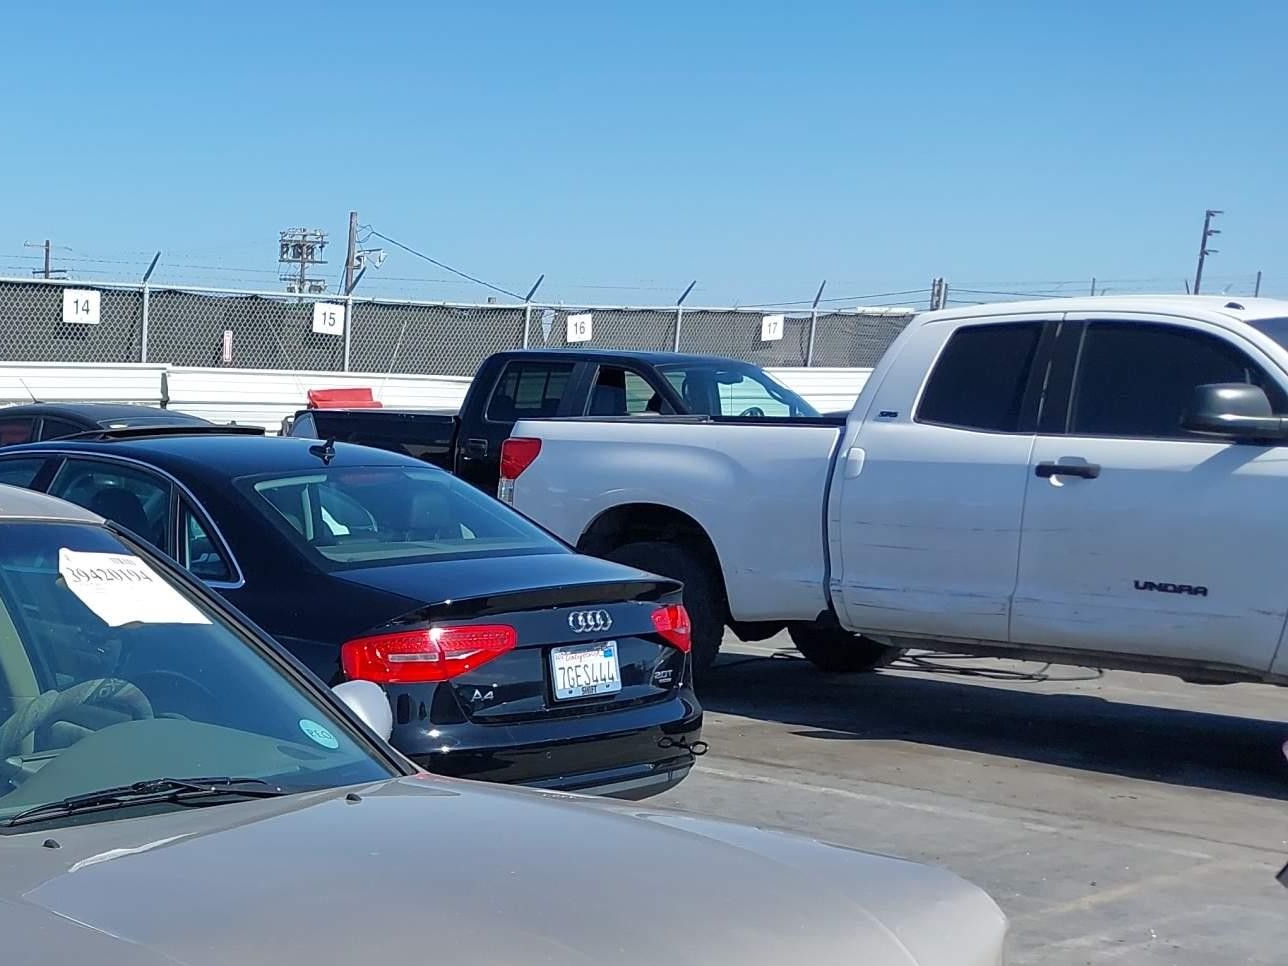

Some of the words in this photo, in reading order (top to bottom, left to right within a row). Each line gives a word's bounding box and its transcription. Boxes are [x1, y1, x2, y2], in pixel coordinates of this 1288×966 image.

[73, 299, 90, 315] 14
[322, 312, 336, 327] 15
[574, 321, 585, 335] 16
[768, 321, 778, 335] 17
[66, 567, 153, 583] 39420194
[558, 660, 615, 690] 7GES444
[470, 689, 494, 702] A4
